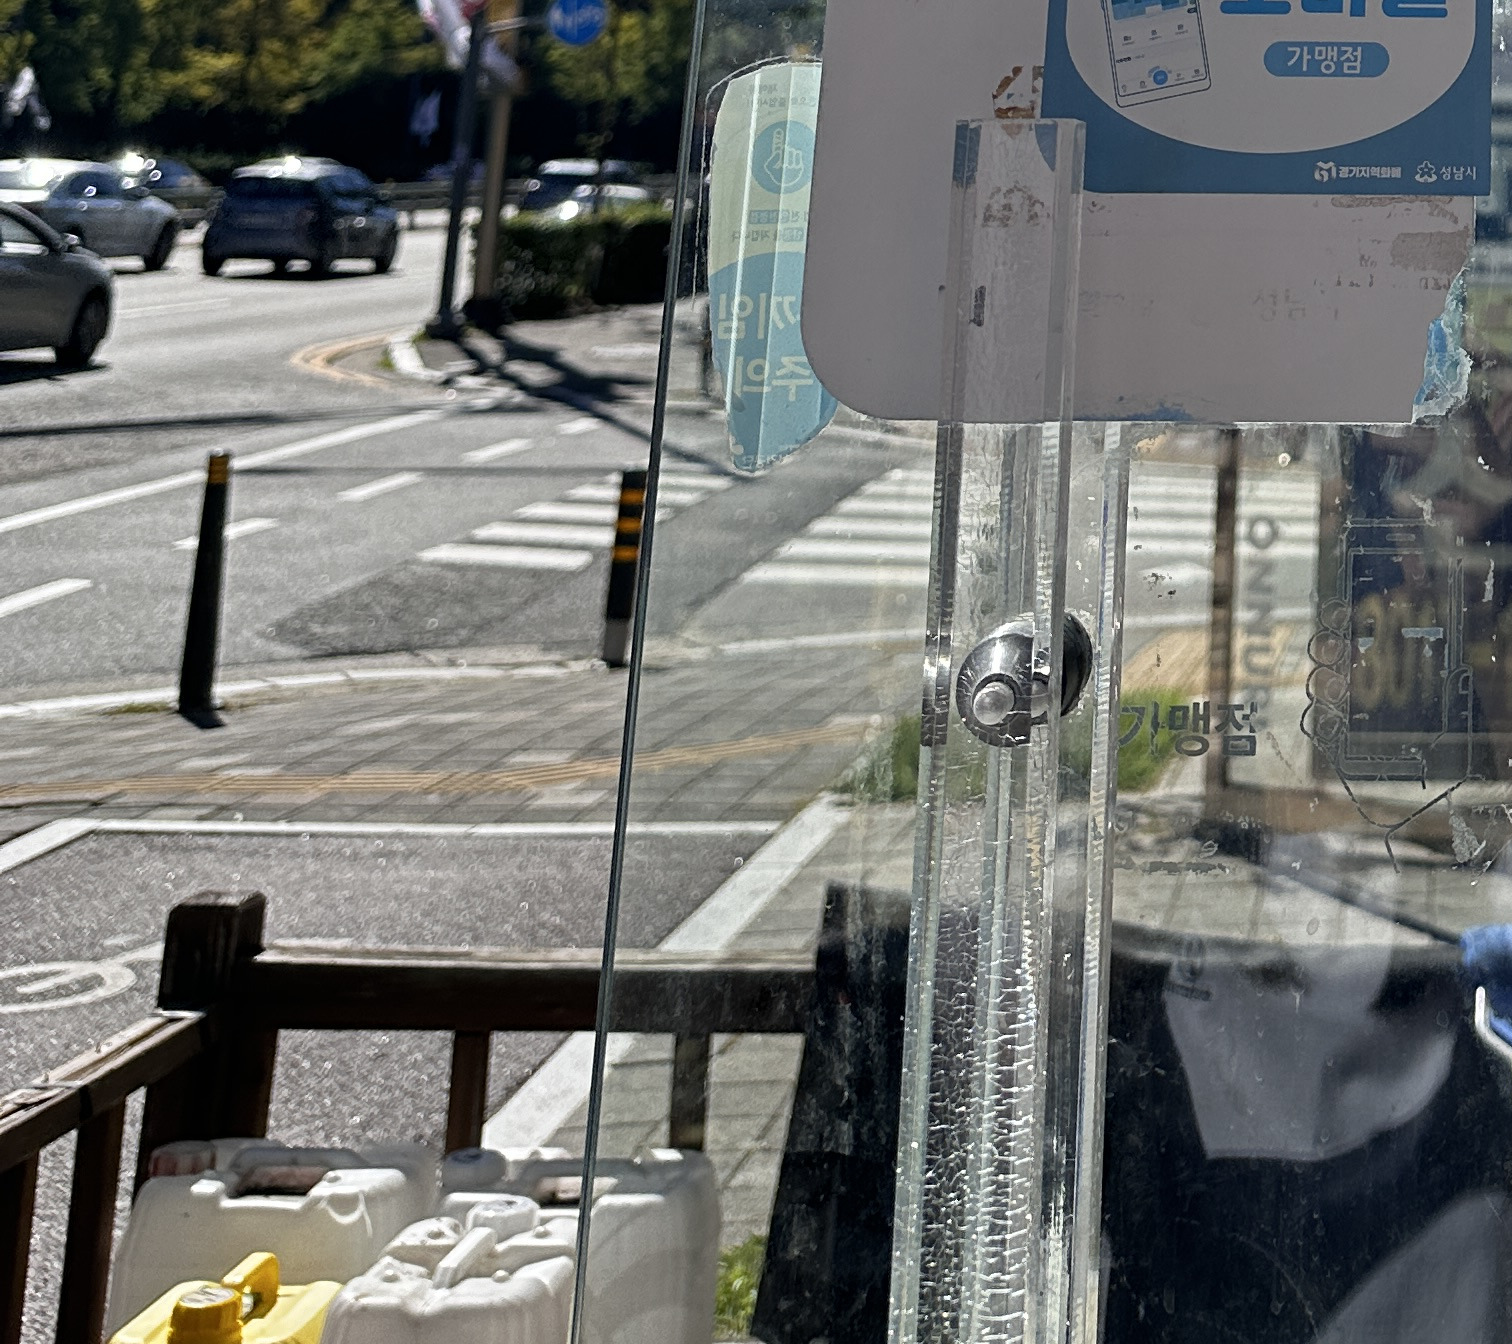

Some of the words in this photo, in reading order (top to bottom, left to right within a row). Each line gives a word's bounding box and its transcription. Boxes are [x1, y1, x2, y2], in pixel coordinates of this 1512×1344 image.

[1286, 47, 1363, 74] 가맹점
[1440, 166, 1477, 181] 성남시
[1118, 700, 1258, 756] 가맹점
